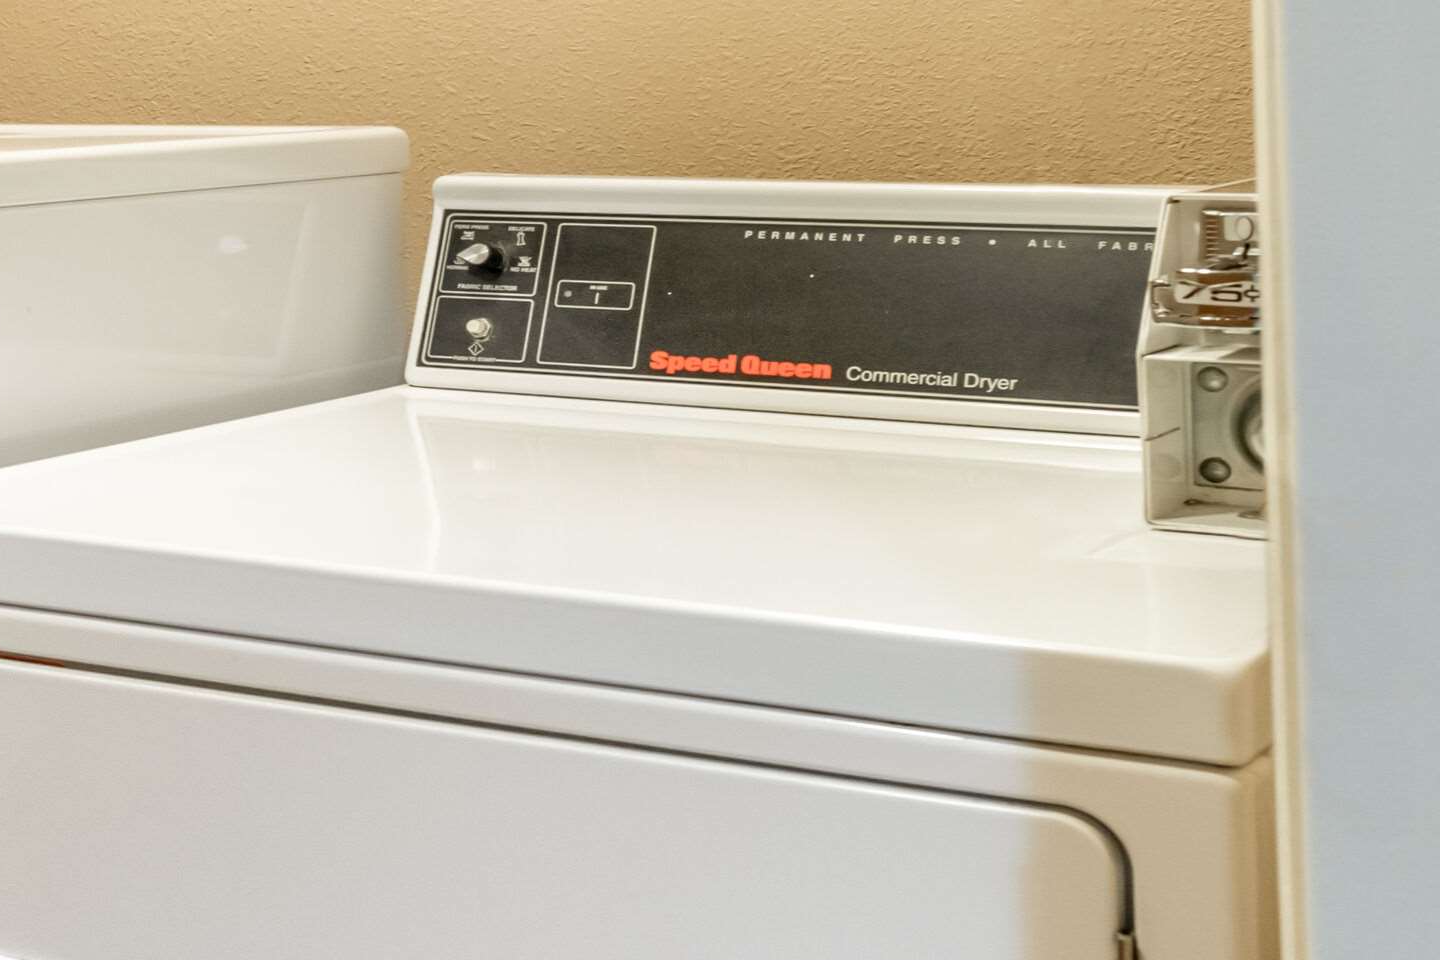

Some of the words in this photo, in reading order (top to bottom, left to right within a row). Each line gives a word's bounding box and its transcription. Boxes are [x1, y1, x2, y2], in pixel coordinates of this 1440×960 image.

[744, 230, 866, 242] PERMANENT
[893, 234, 961, 245] PRESS
[1027, 239, 1066, 249] ALL
[649, 350, 737, 375] Speed
[740, 355, 832, 380] Queen
[845, 366, 958, 388] Commercial
[963, 373, 1019, 393] Dryer
